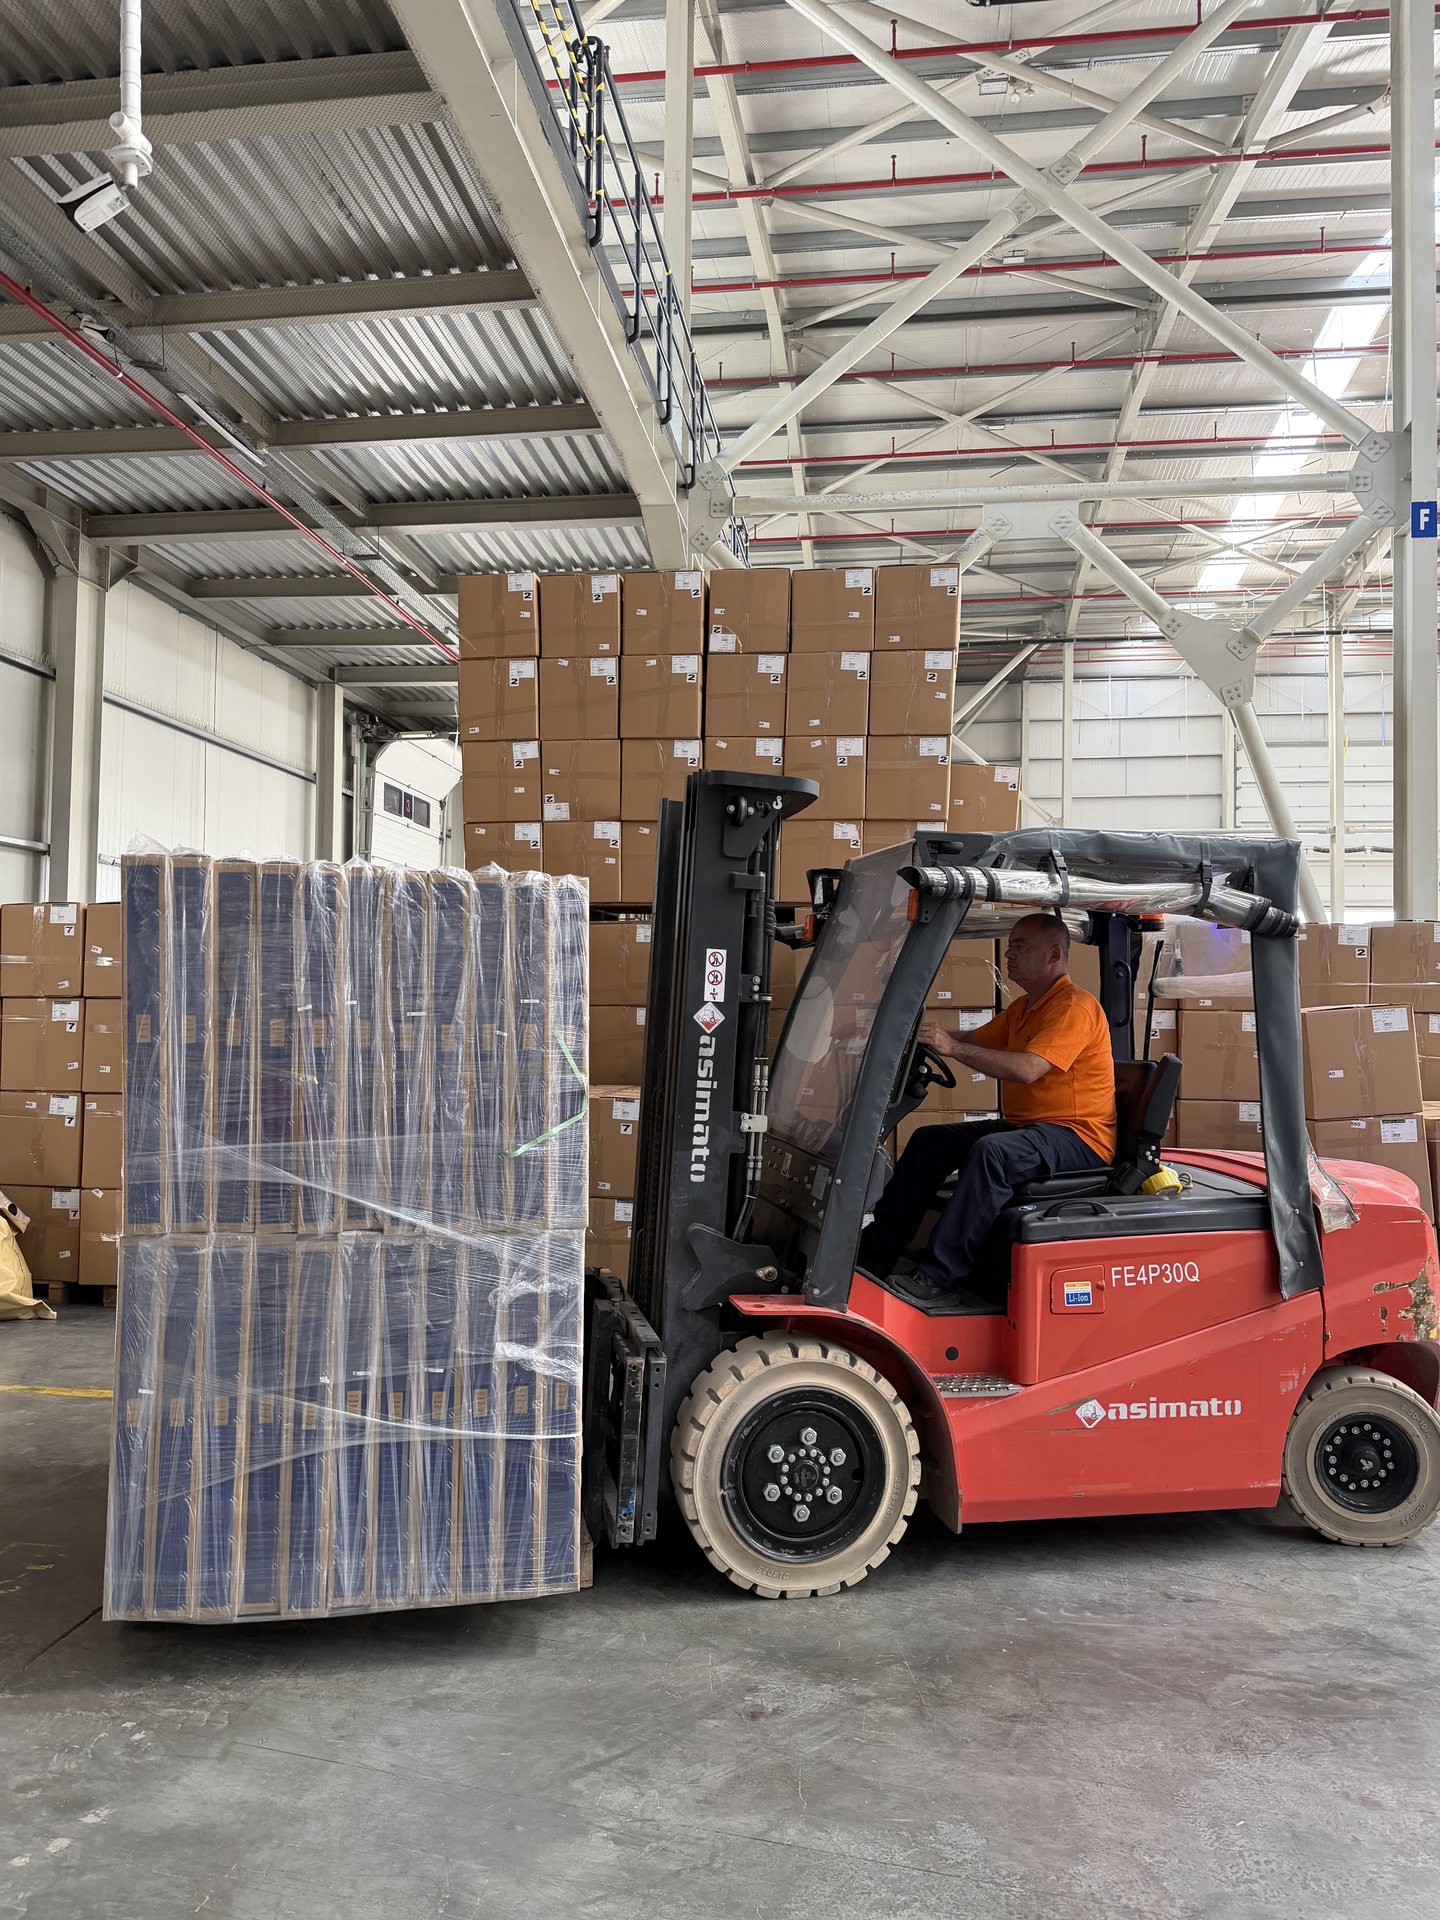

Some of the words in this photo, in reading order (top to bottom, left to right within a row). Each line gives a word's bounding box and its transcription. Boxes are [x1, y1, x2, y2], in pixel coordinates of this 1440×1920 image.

[1419, 508, 1431, 531] F
[692, 588, 700, 597] 2
[863, 586, 871, 594] 2
[948, 586, 957, 594] 2
[523, 591, 532, 600] 2
[593, 593, 602, 602] 2
[713, 626, 721, 634] 2
[687, 673, 696, 681] 2
[771, 674, 780, 682] 2
[858, 670, 866, 678] 2
[927, 673, 936, 681] 2
[510, 677, 518, 685] 2
[607, 676, 615, 684] 2
[515, 760, 523, 768] 2
[688, 757, 697, 765] 2
[773, 756, 782, 764] 2
[838, 757, 846, 765] 2
[939, 756, 948, 764] 2
[1009, 782, 1017, 790] 4
[545, 795, 554, 803] 2
[531, 840, 539, 848] 2
[610, 839, 619, 847] 2
[851, 839, 860, 847] 2
[65, 926, 74, 934] 7
[1357, 948, 1366, 957] 2
[67, 1022, 76, 1030] 7
[690, 1034, 718, 1183] asimato
[66, 1116, 75, 1125] 7
[621, 1123, 631, 1132] 7
[70, 1209, 79, 1218] 7
[1111, 1261, 1200, 1287] FE4P30Q
[1068, 1293, 1089, 1303] Li-Ion
[1107, 1397, 1242, 1420] asimato
